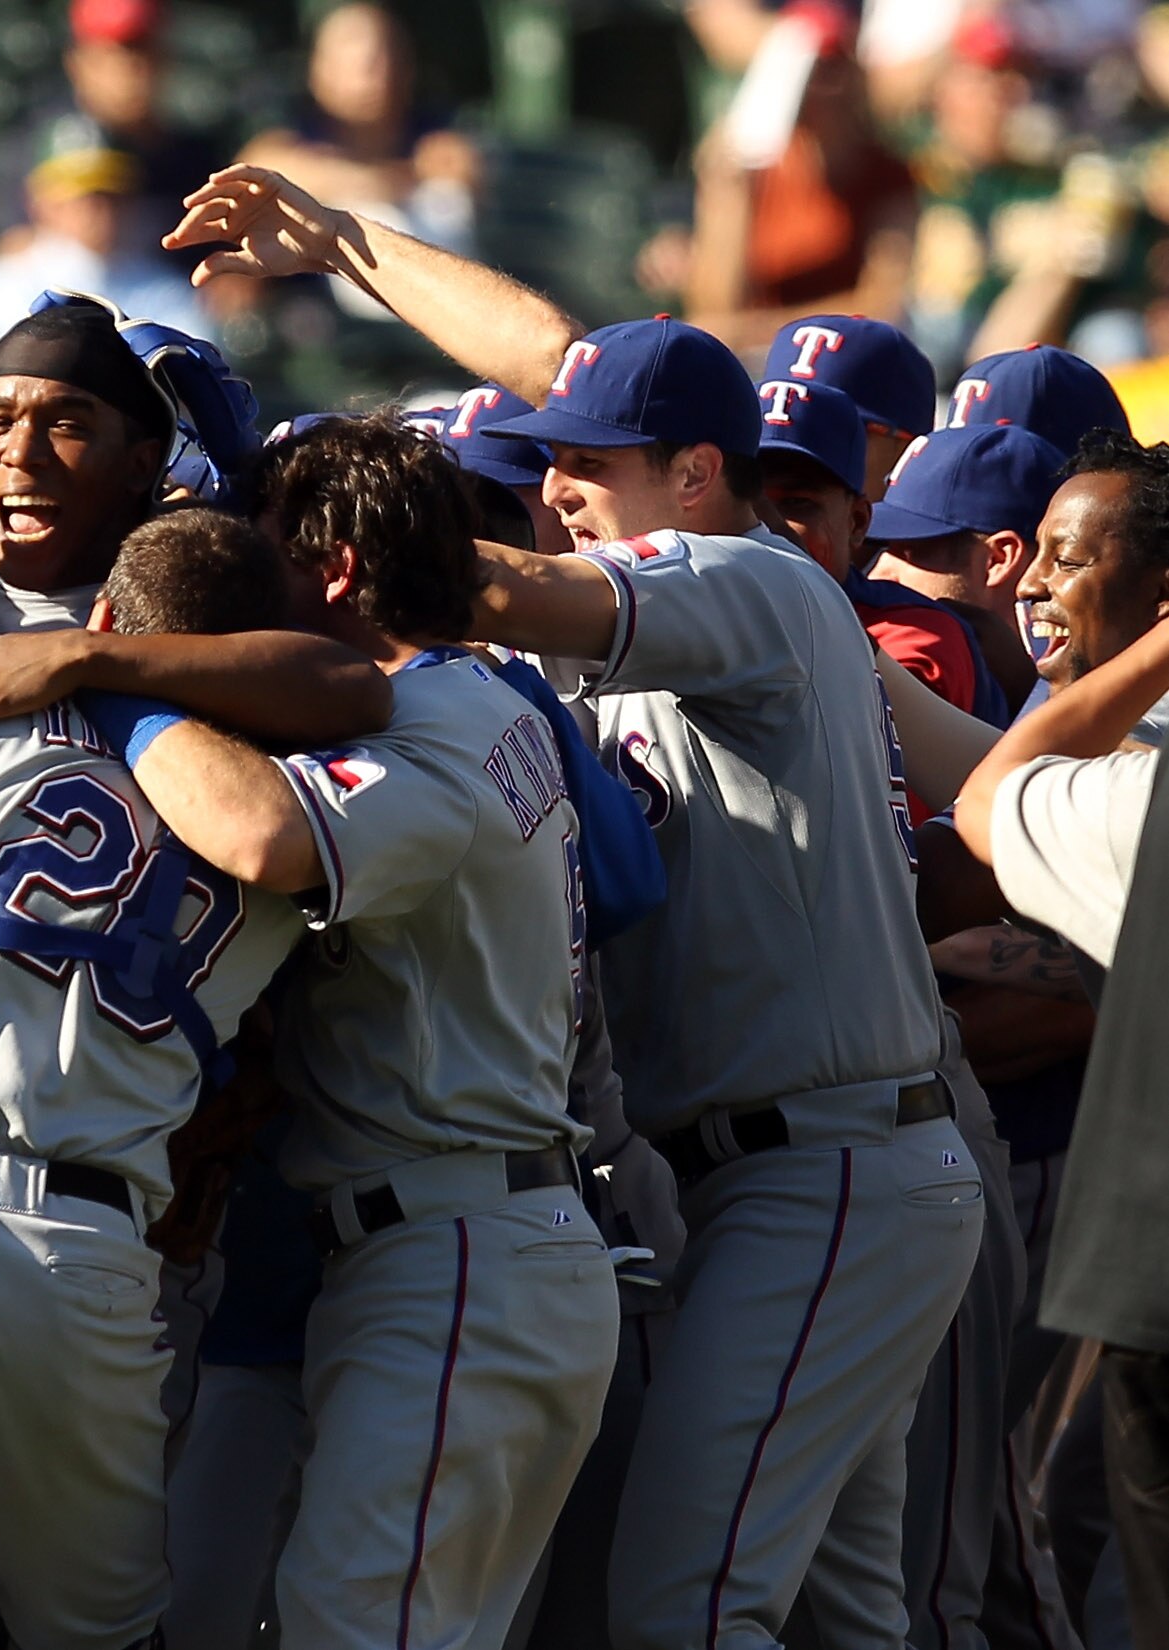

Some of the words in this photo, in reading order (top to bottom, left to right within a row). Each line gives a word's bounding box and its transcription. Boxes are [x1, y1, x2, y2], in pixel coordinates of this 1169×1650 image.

[551, 340, 600, 396] T
[789, 326, 844, 378] T
[448, 387, 501, 438] T
[759, 380, 810, 426] T
[949, 379, 992, 428] T
